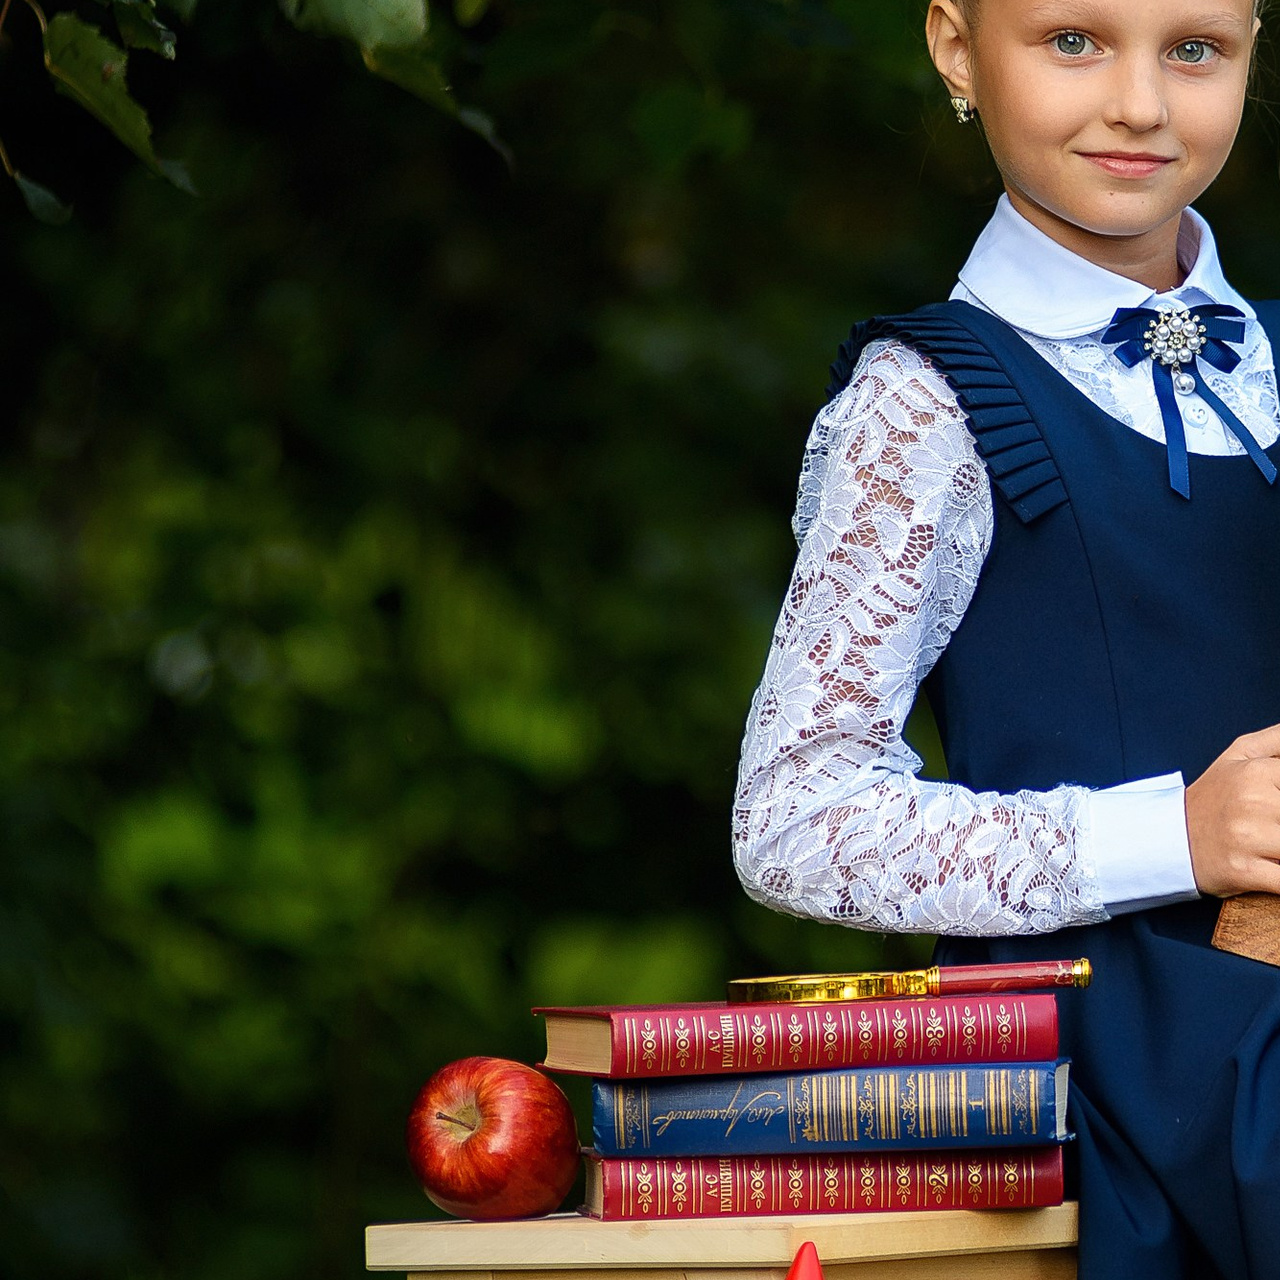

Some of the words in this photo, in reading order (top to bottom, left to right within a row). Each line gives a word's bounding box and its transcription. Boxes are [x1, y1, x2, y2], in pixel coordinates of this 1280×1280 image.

[925, 1025, 945, 1039] 3
[720, 1014, 735, 1067] ПУШКИН
[968, 1098, 984, 1111] 1
[719, 1160, 732, 1212] ПУШКИН
[928, 1173, 949, 1187] 2
